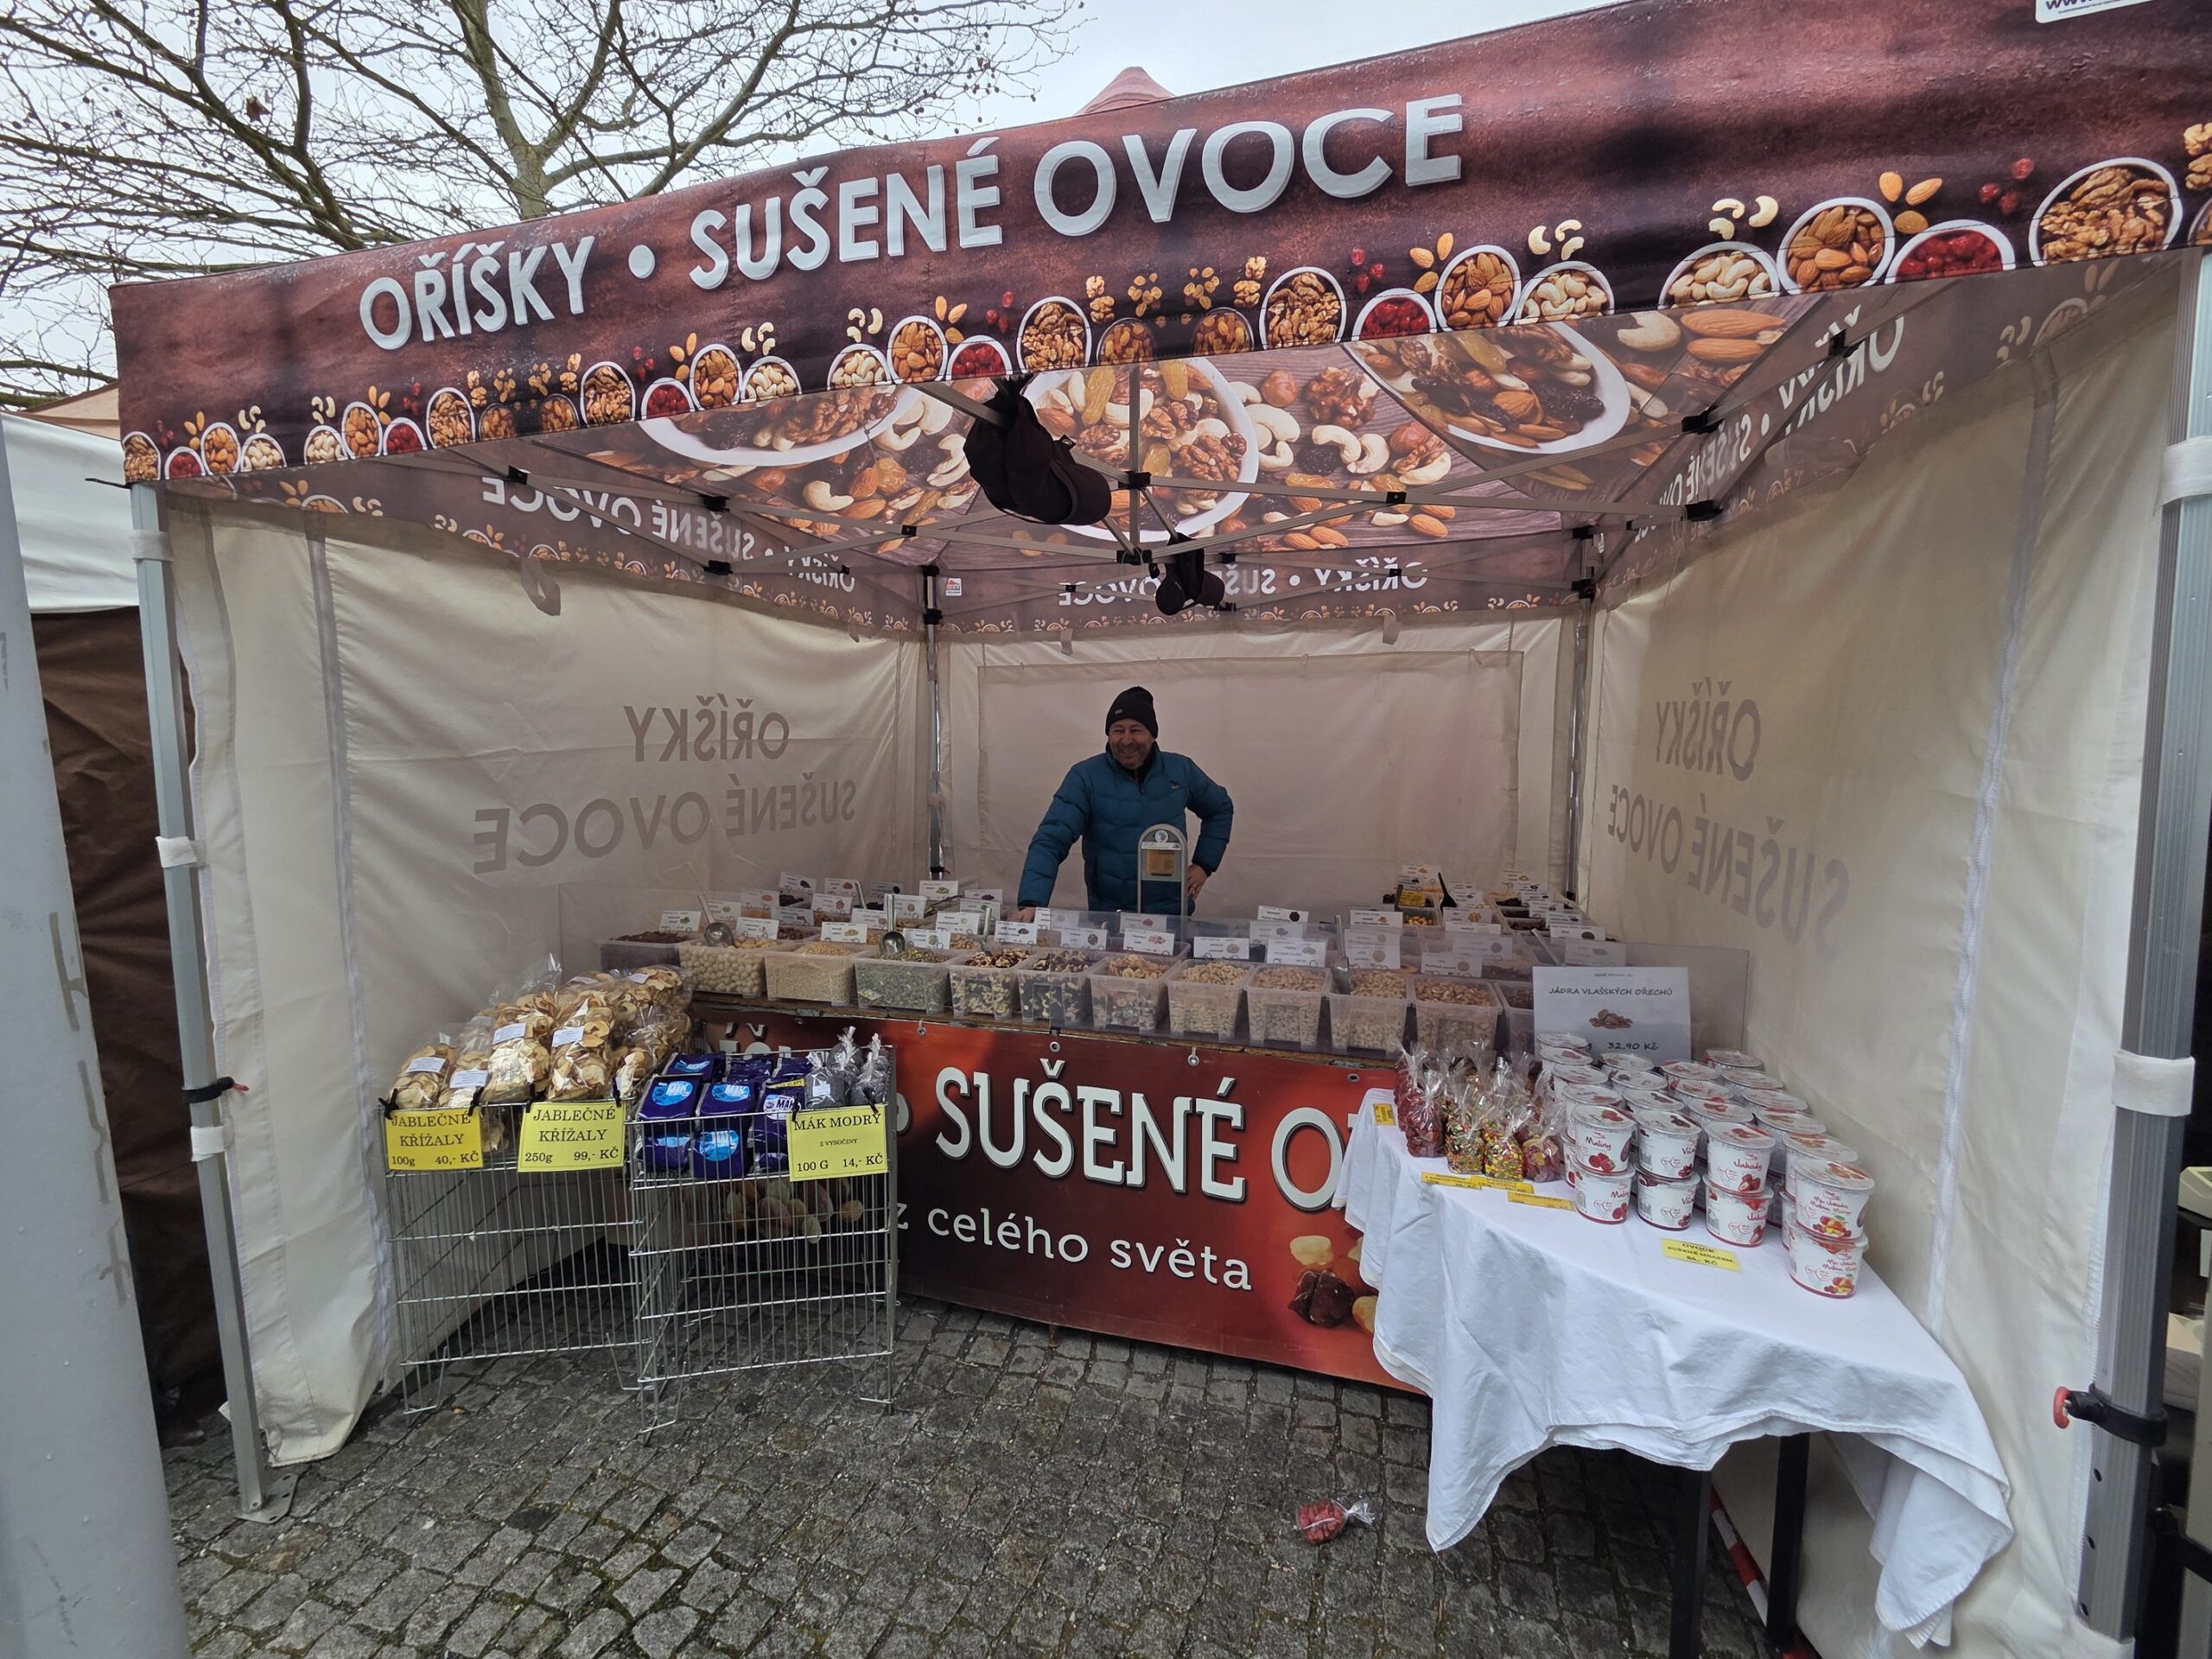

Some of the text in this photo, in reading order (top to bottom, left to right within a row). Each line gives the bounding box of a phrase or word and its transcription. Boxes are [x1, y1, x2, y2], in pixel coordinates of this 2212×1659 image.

[359, 92, 1463, 351] OŘÍŠKY SUŠENÉ OVOCE
[1549, 986, 1580, 995] JÁDRA
[391, 1110, 471, 1127] JABLEČNÉ
[533, 1107, 616, 1122] JABLEČNÉ
[794, 1116, 827, 1131] MÁK
[936, 1058, 1247, 1203] SUŠENÉ
[399, 1134, 465, 1147] KŘÍŽALY
[538, 1128, 607, 1142] KŘÍŽALY
[825, 1138, 858, 1147] VYSOČINY
[1585, 1136, 1611, 1151] Maliny
[391, 1156, 415, 1166] 100g
[460, 1150, 479, 1163] KČ
[524, 1146, 619, 1163] 250g 99,- KČ
[798, 1161, 817, 1172] 100
[820, 1160, 829, 1170] G
[866, 1153, 883, 1166] KČ
[928, 1207, 1089, 1263] celého
[1110, 1237, 1252, 1291] světa
